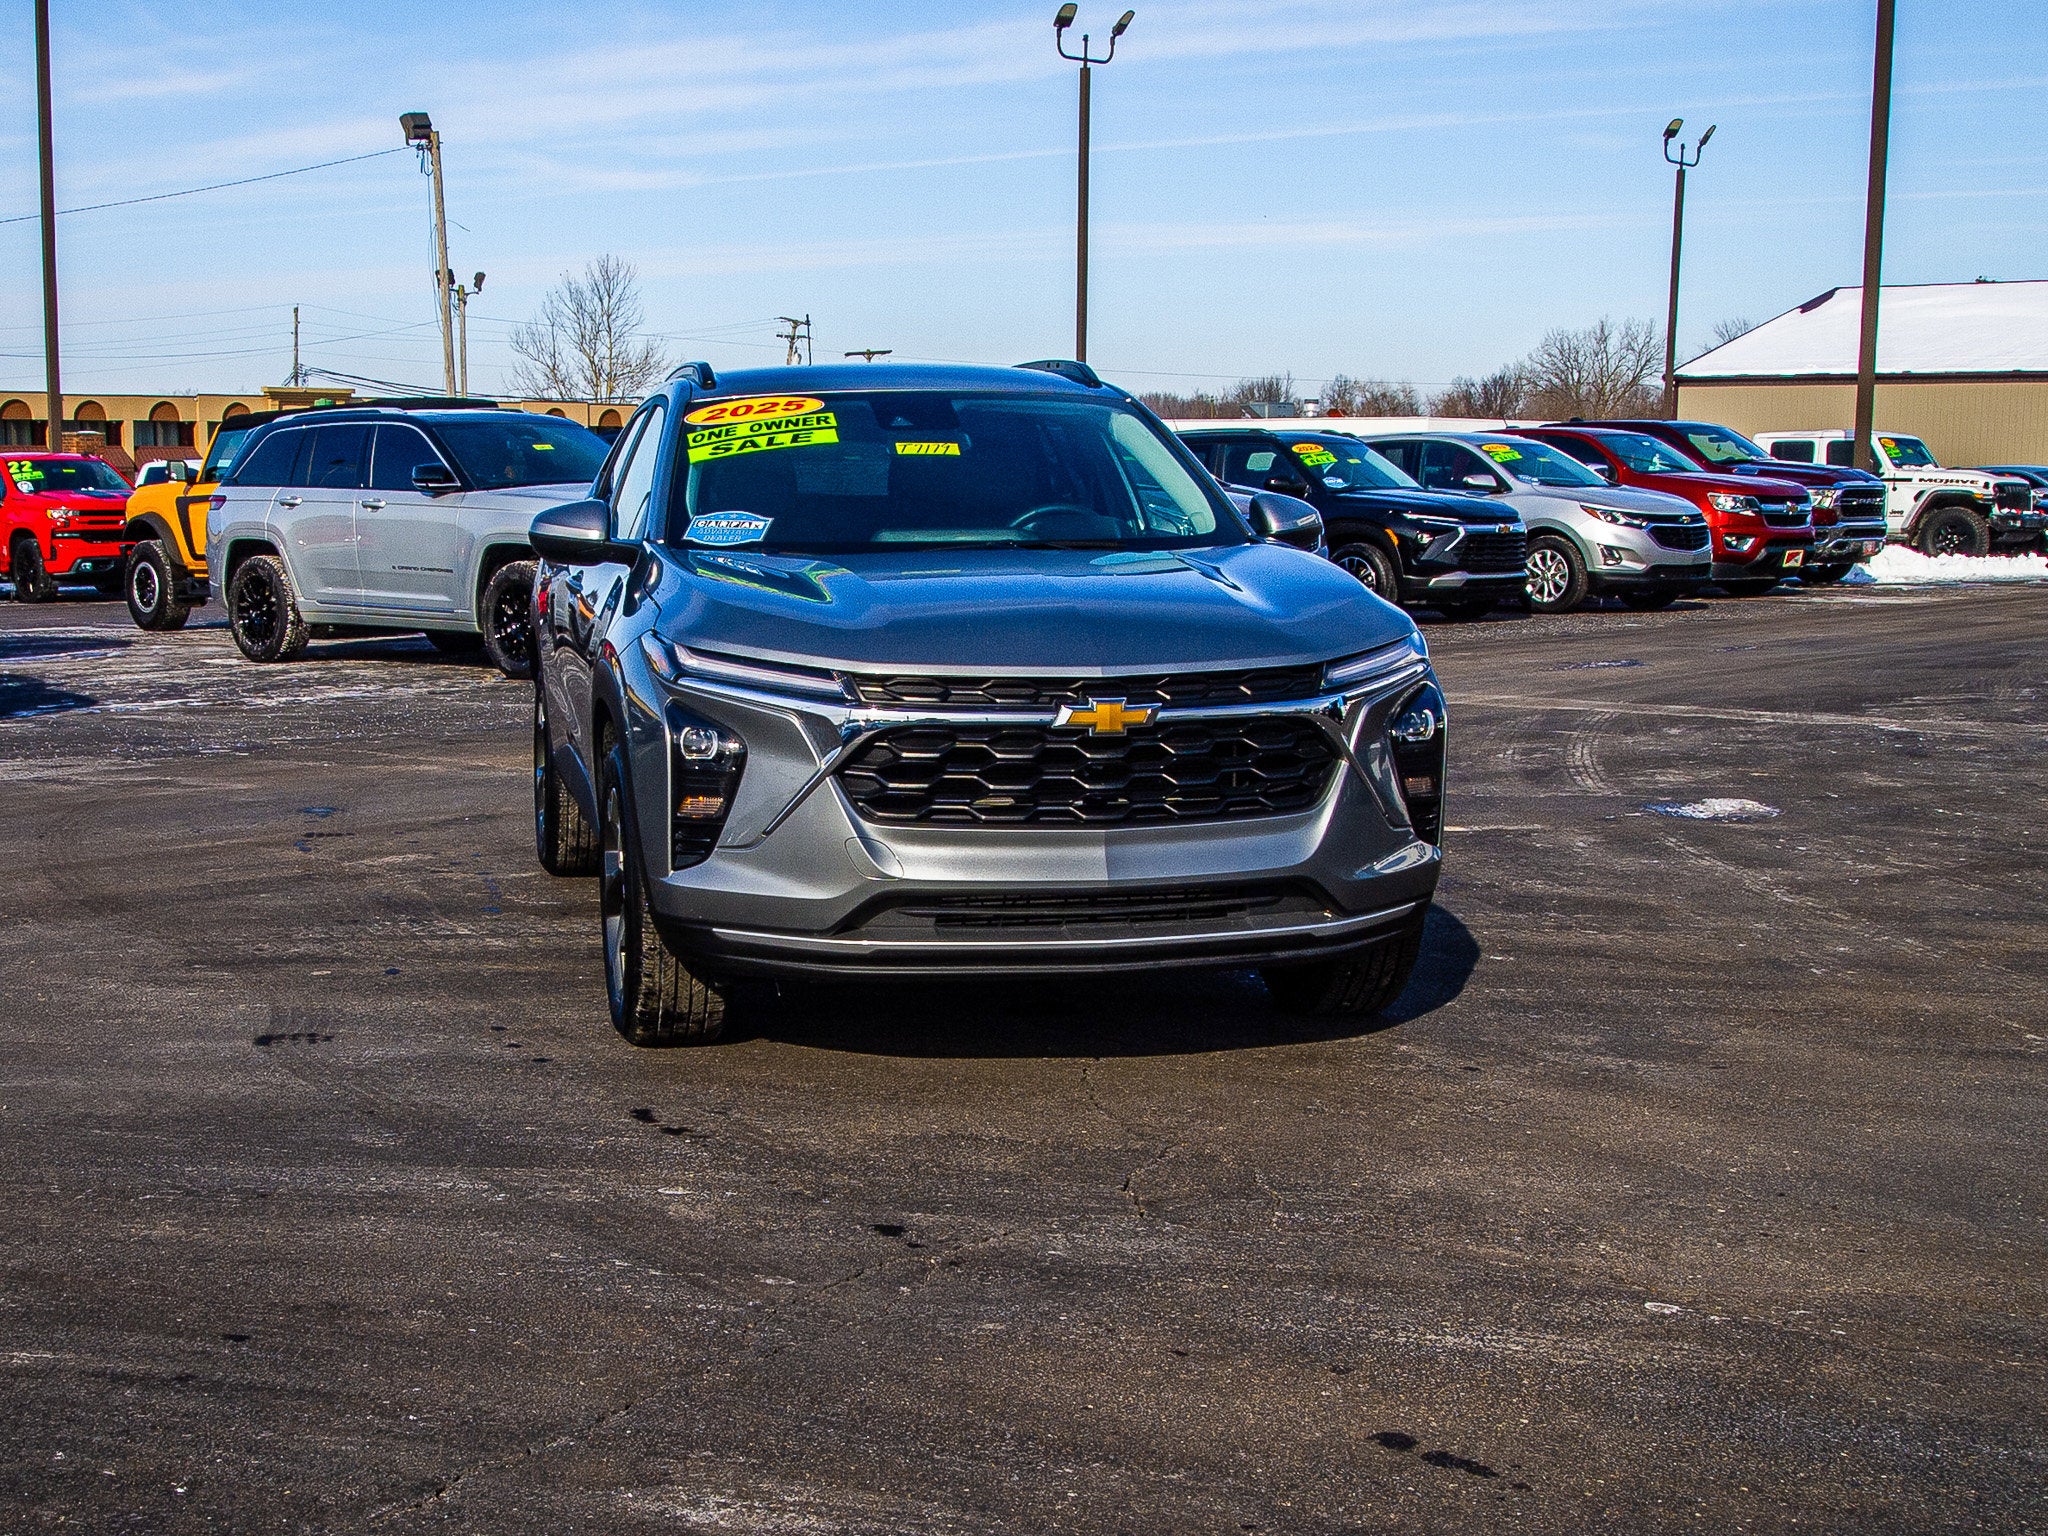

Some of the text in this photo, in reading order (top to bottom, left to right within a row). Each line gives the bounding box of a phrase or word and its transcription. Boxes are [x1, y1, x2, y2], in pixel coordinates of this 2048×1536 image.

[702, 400, 806, 422] 2025
[692, 415, 832, 444] ONE OWNER
[709, 432, 813, 456] SALE
[7, 460, 33, 473] 22
[1918, 477, 1979, 485] MOJAVE
[1889, 508, 1904, 516] Jeep
[695, 520, 764, 529] CARFAX
